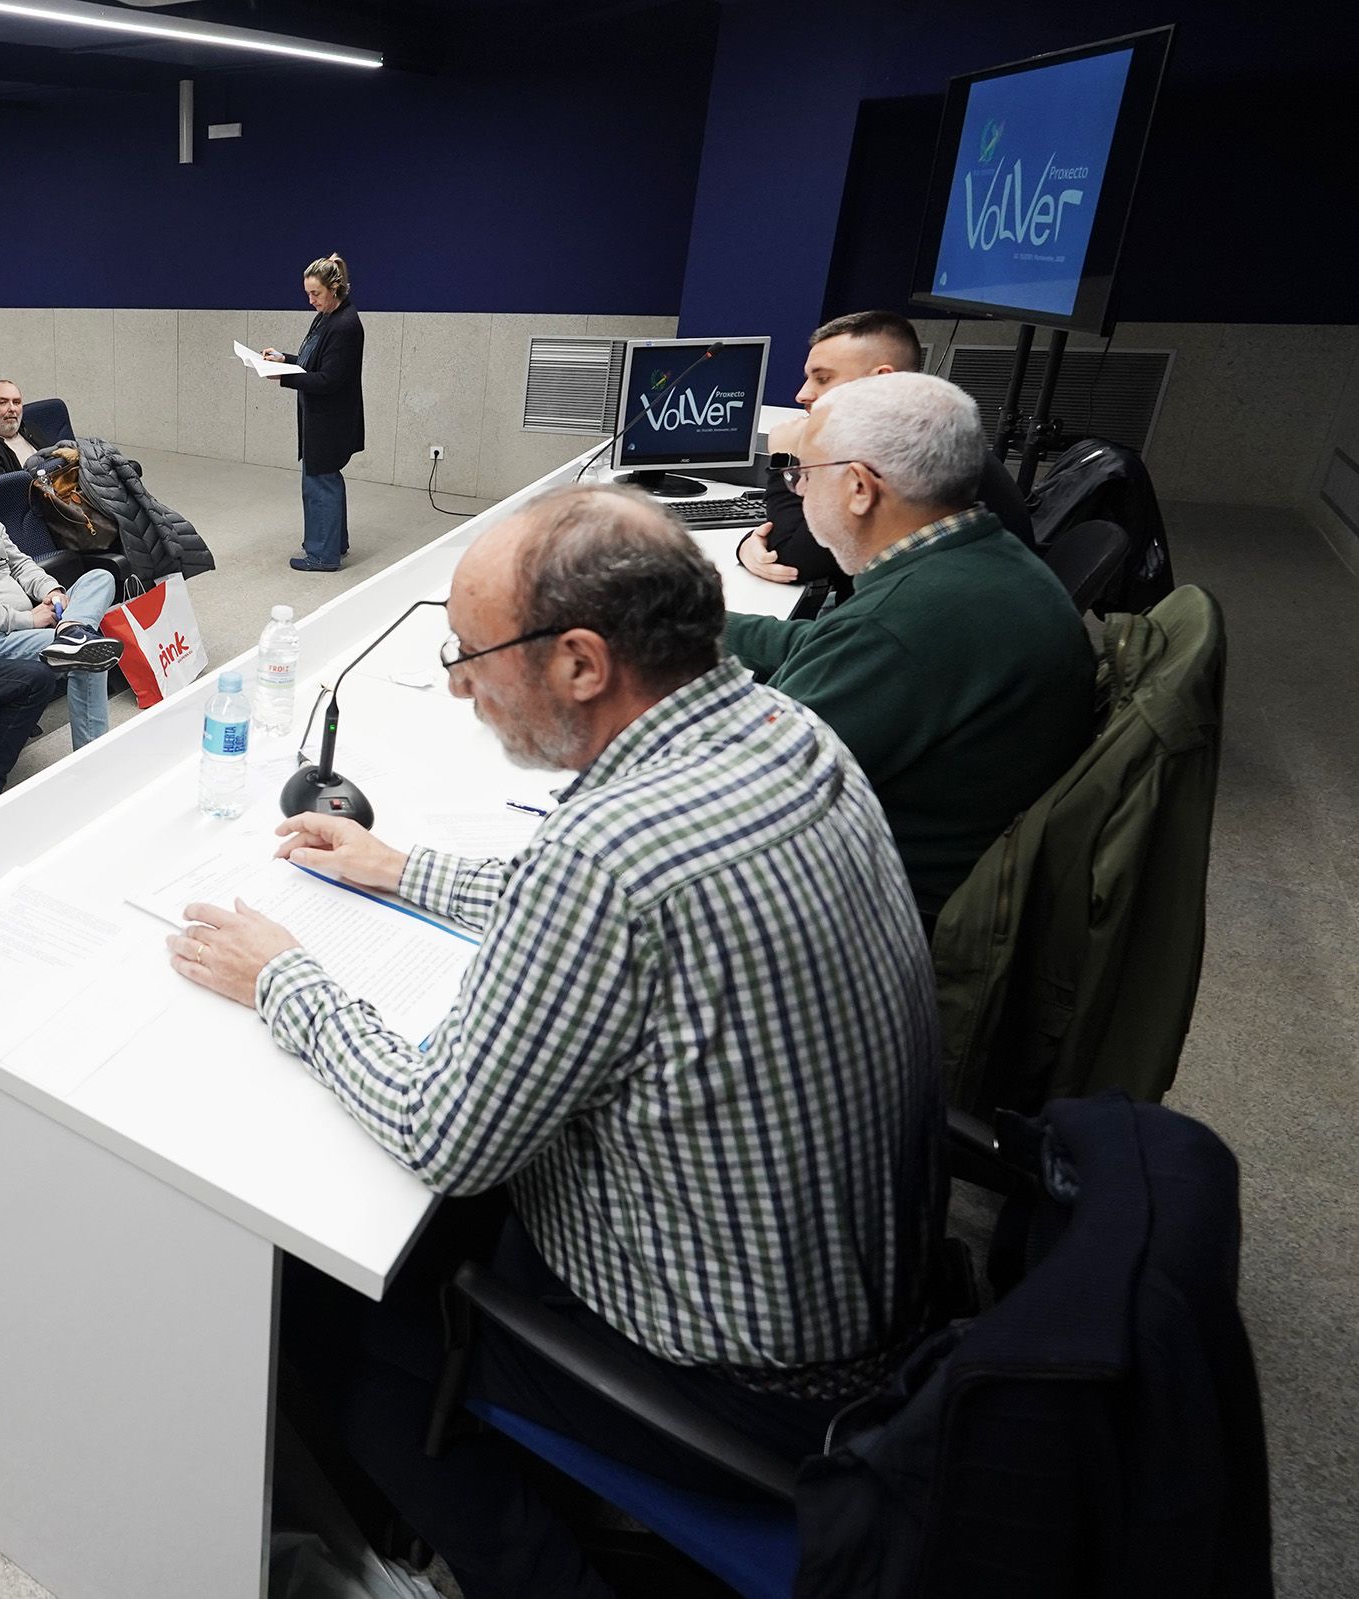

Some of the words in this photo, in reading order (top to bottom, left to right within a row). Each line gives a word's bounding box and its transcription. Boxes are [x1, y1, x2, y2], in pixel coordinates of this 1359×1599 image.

[1048, 164, 1089, 181] Proxecto
[715, 390, 746, 399] Proxecto
[222, 725, 237, 753] HUERTA
